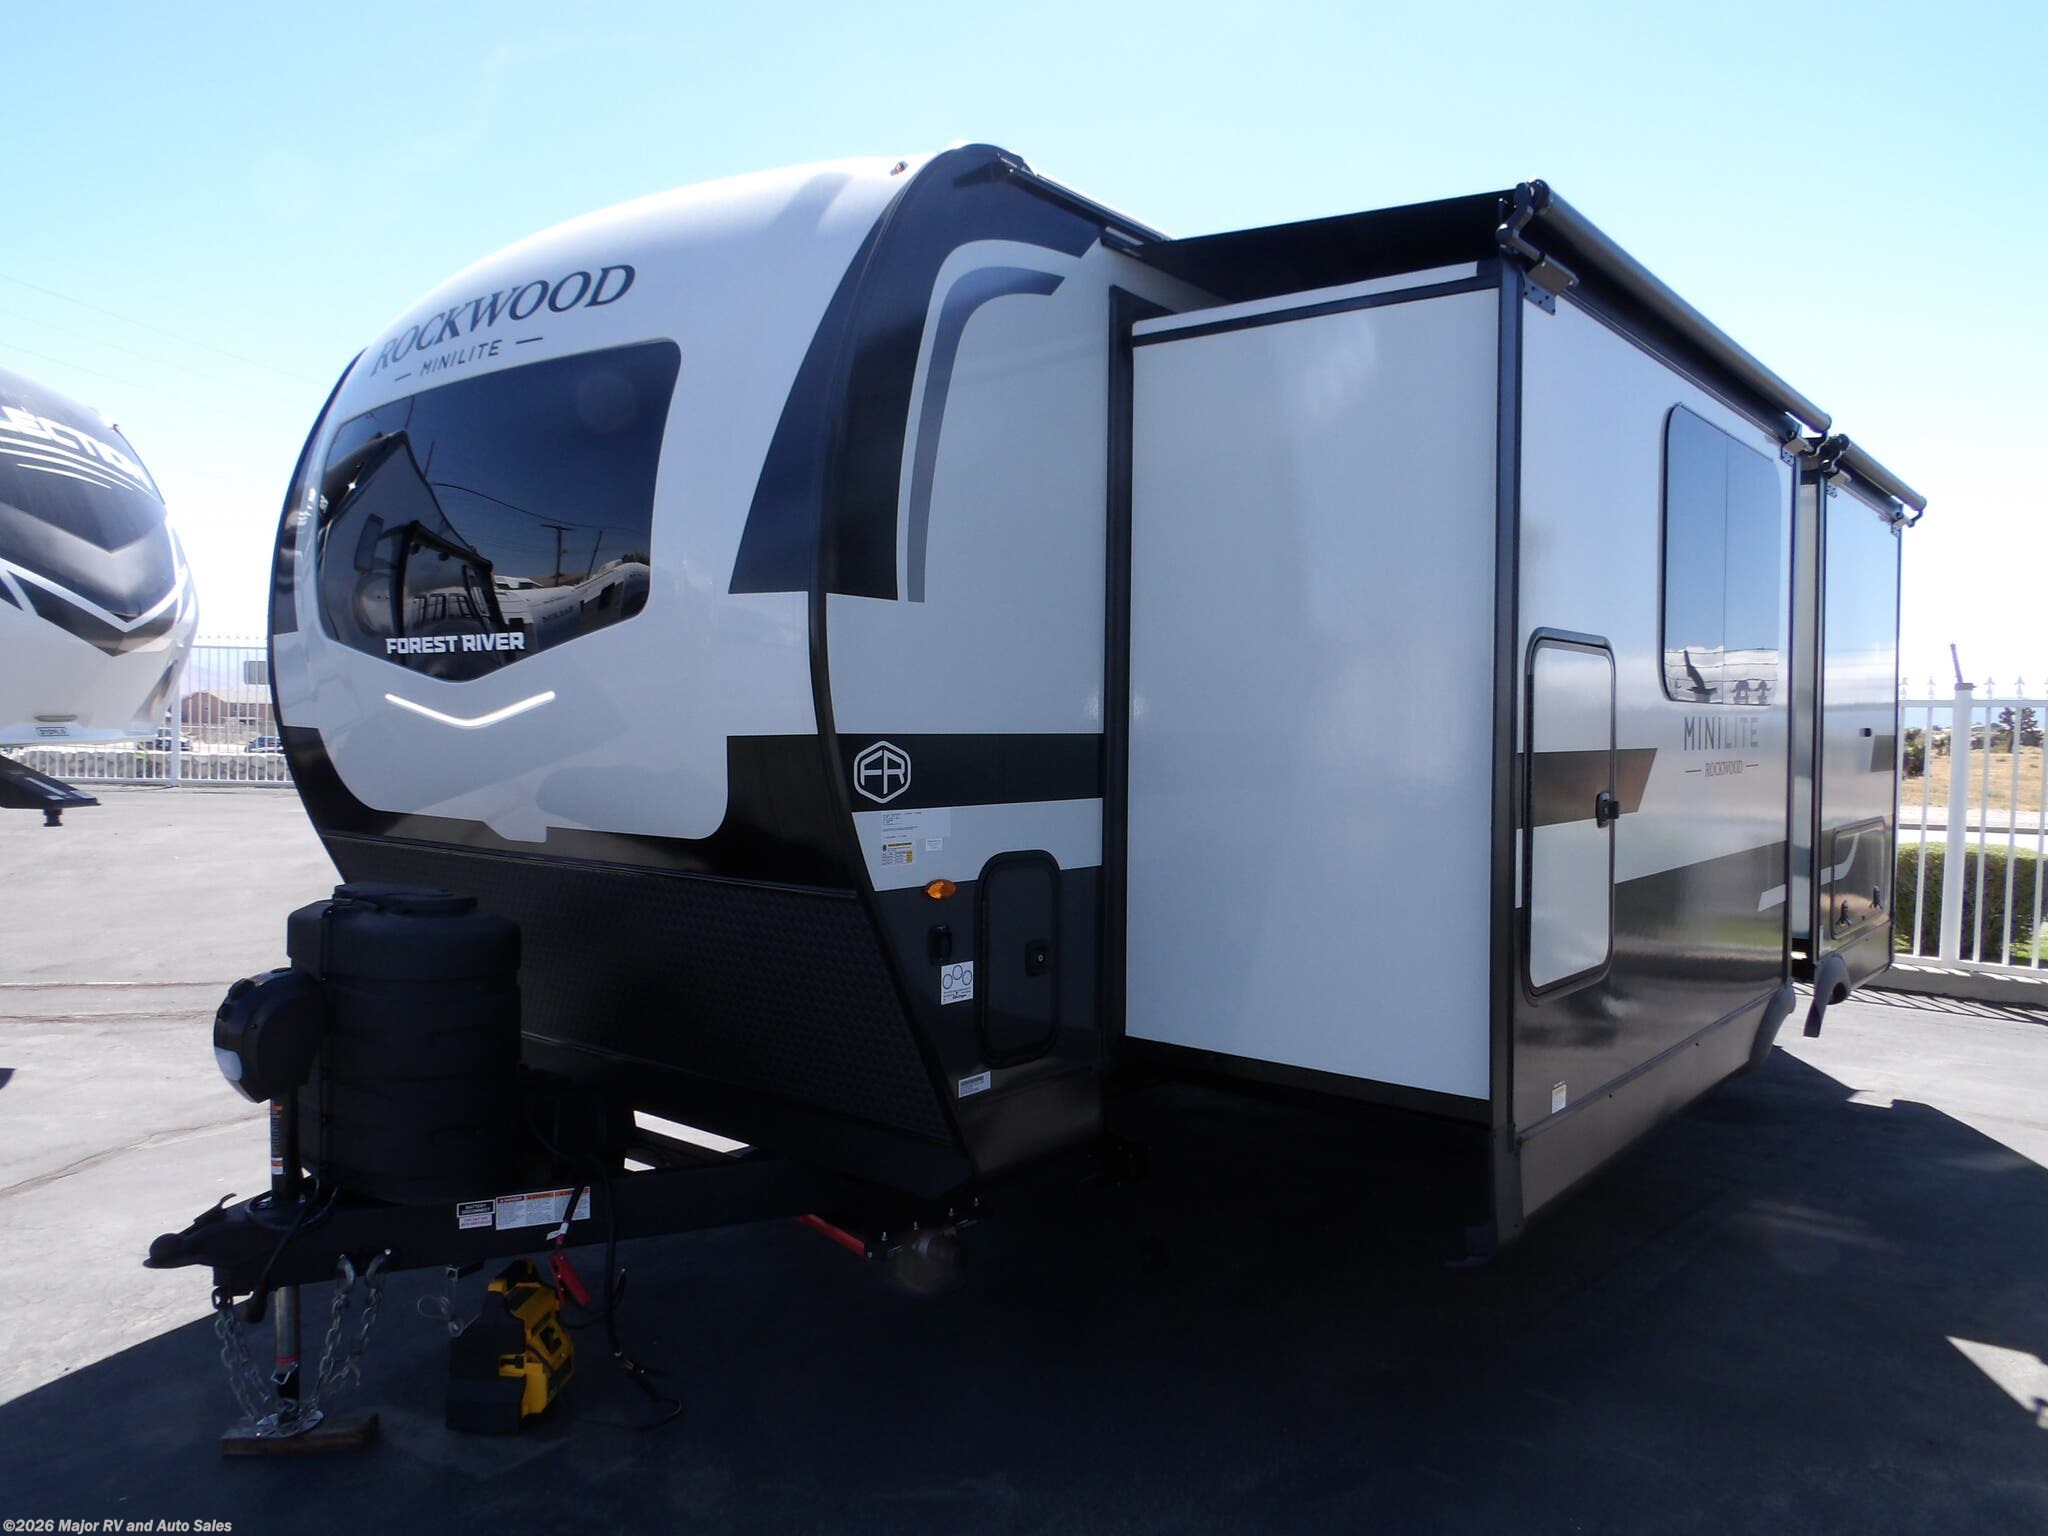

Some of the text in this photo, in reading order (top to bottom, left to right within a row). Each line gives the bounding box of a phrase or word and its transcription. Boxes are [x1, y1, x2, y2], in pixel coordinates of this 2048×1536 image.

[370, 264, 636, 377] ROCKWOOD
[419, 339, 503, 376] MINILITE
[385, 631, 526, 654] FOREST RIVER
[1683, 716, 1760, 751] MINILITE
[1704, 760, 1743, 777] ROCKWOOD
